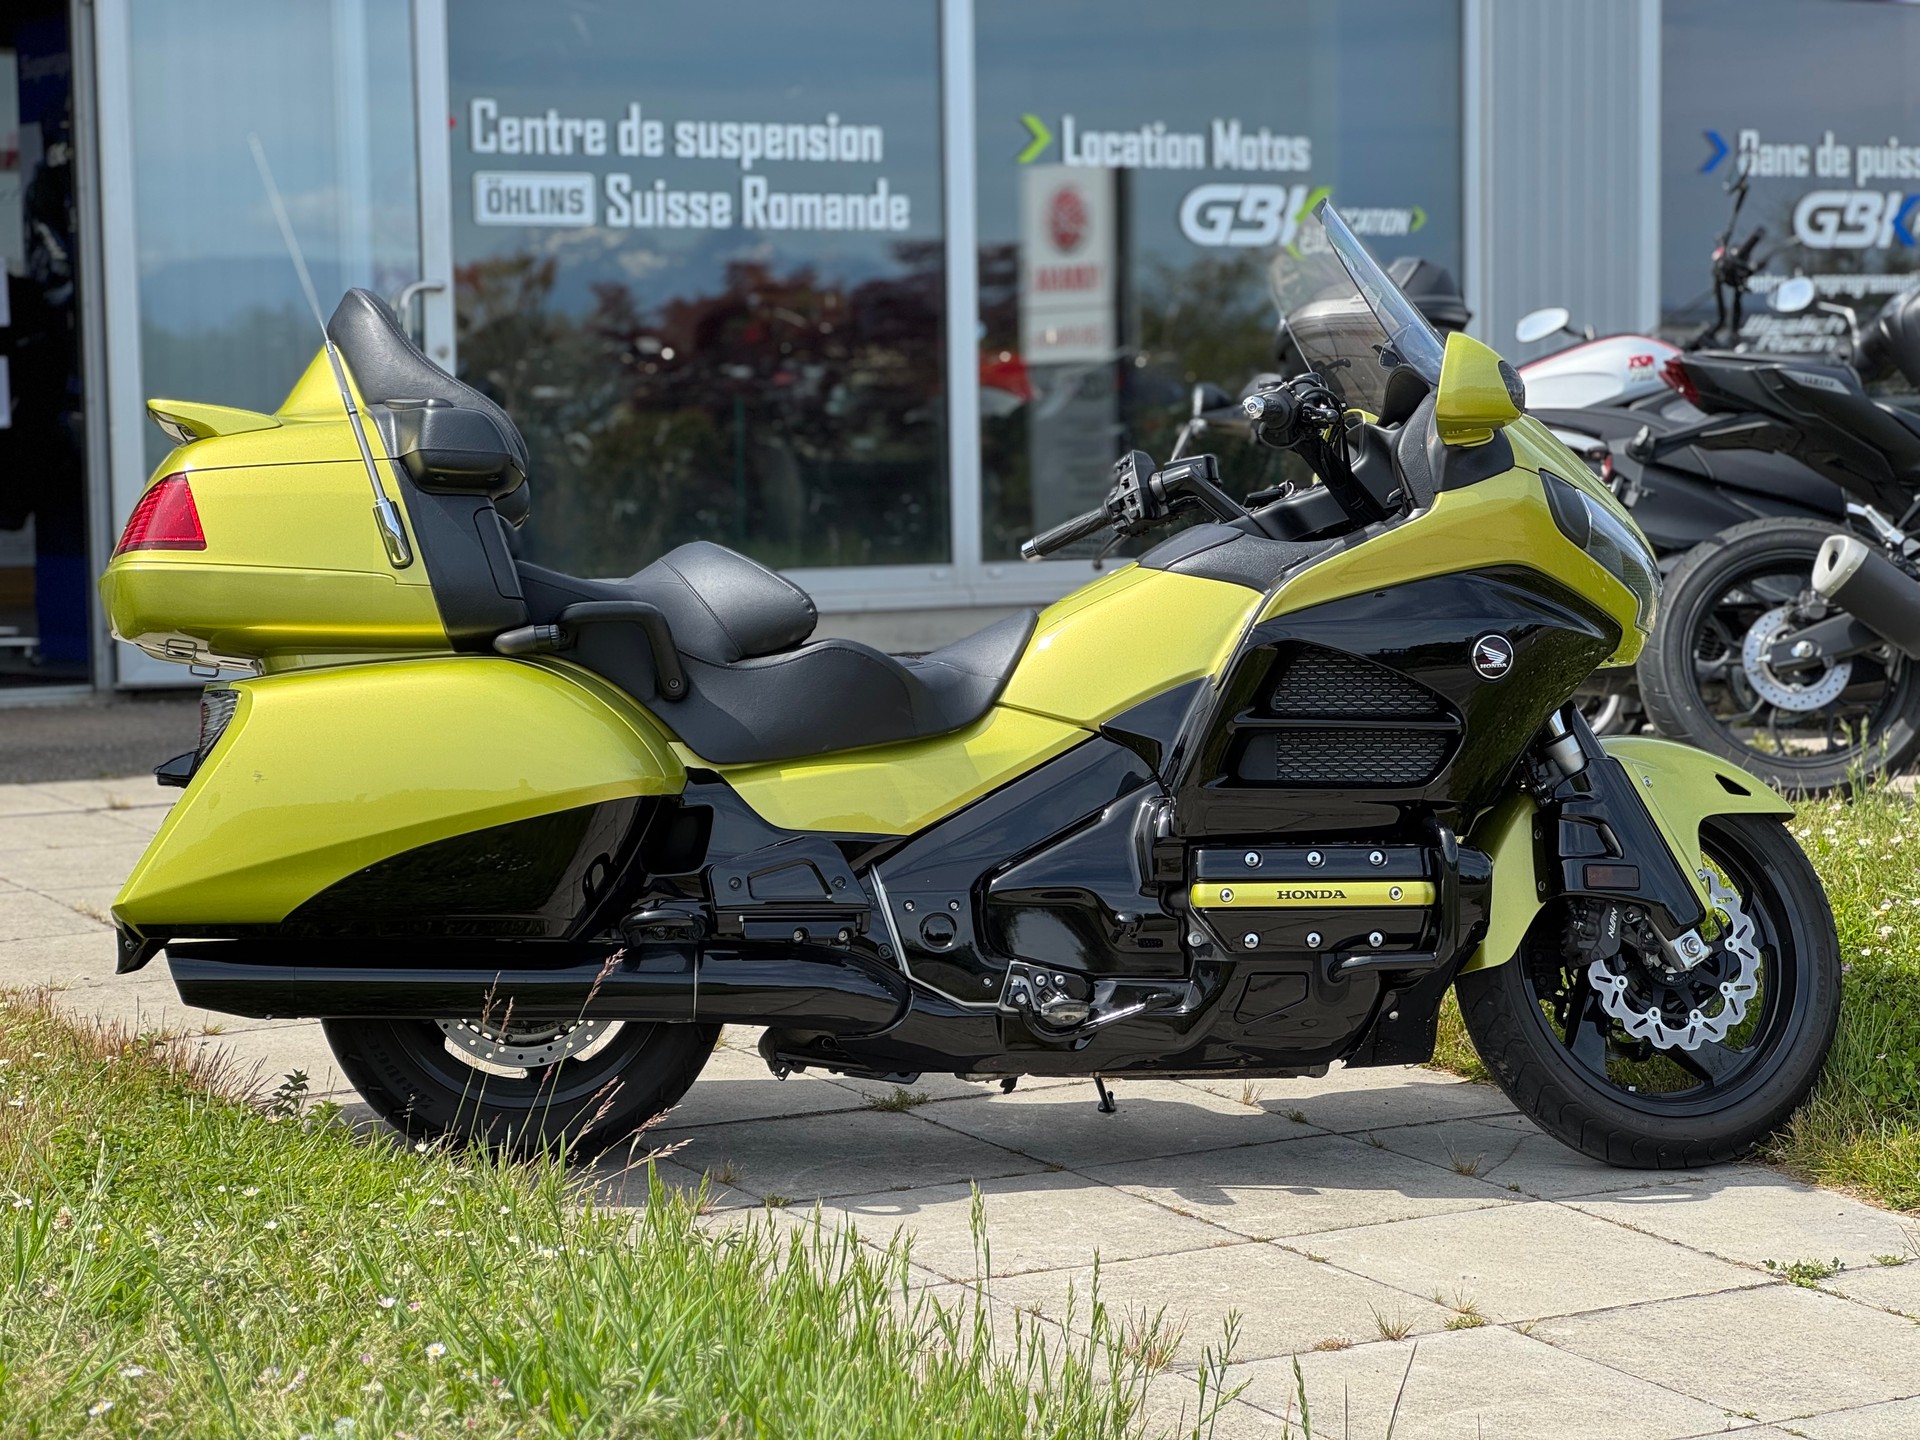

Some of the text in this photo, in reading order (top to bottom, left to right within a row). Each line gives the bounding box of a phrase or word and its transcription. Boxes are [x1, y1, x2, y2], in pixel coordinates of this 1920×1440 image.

[470, 97, 884, 171] Centre de suspension
[1061, 114, 1313, 173] Location Motos
[1815, 130, 1851, 178] de
[485, 177, 586, 217] ÖHLINS
[605, 173, 911, 231] Suisse Romande
[1276, 889, 1348, 900] HONDA
